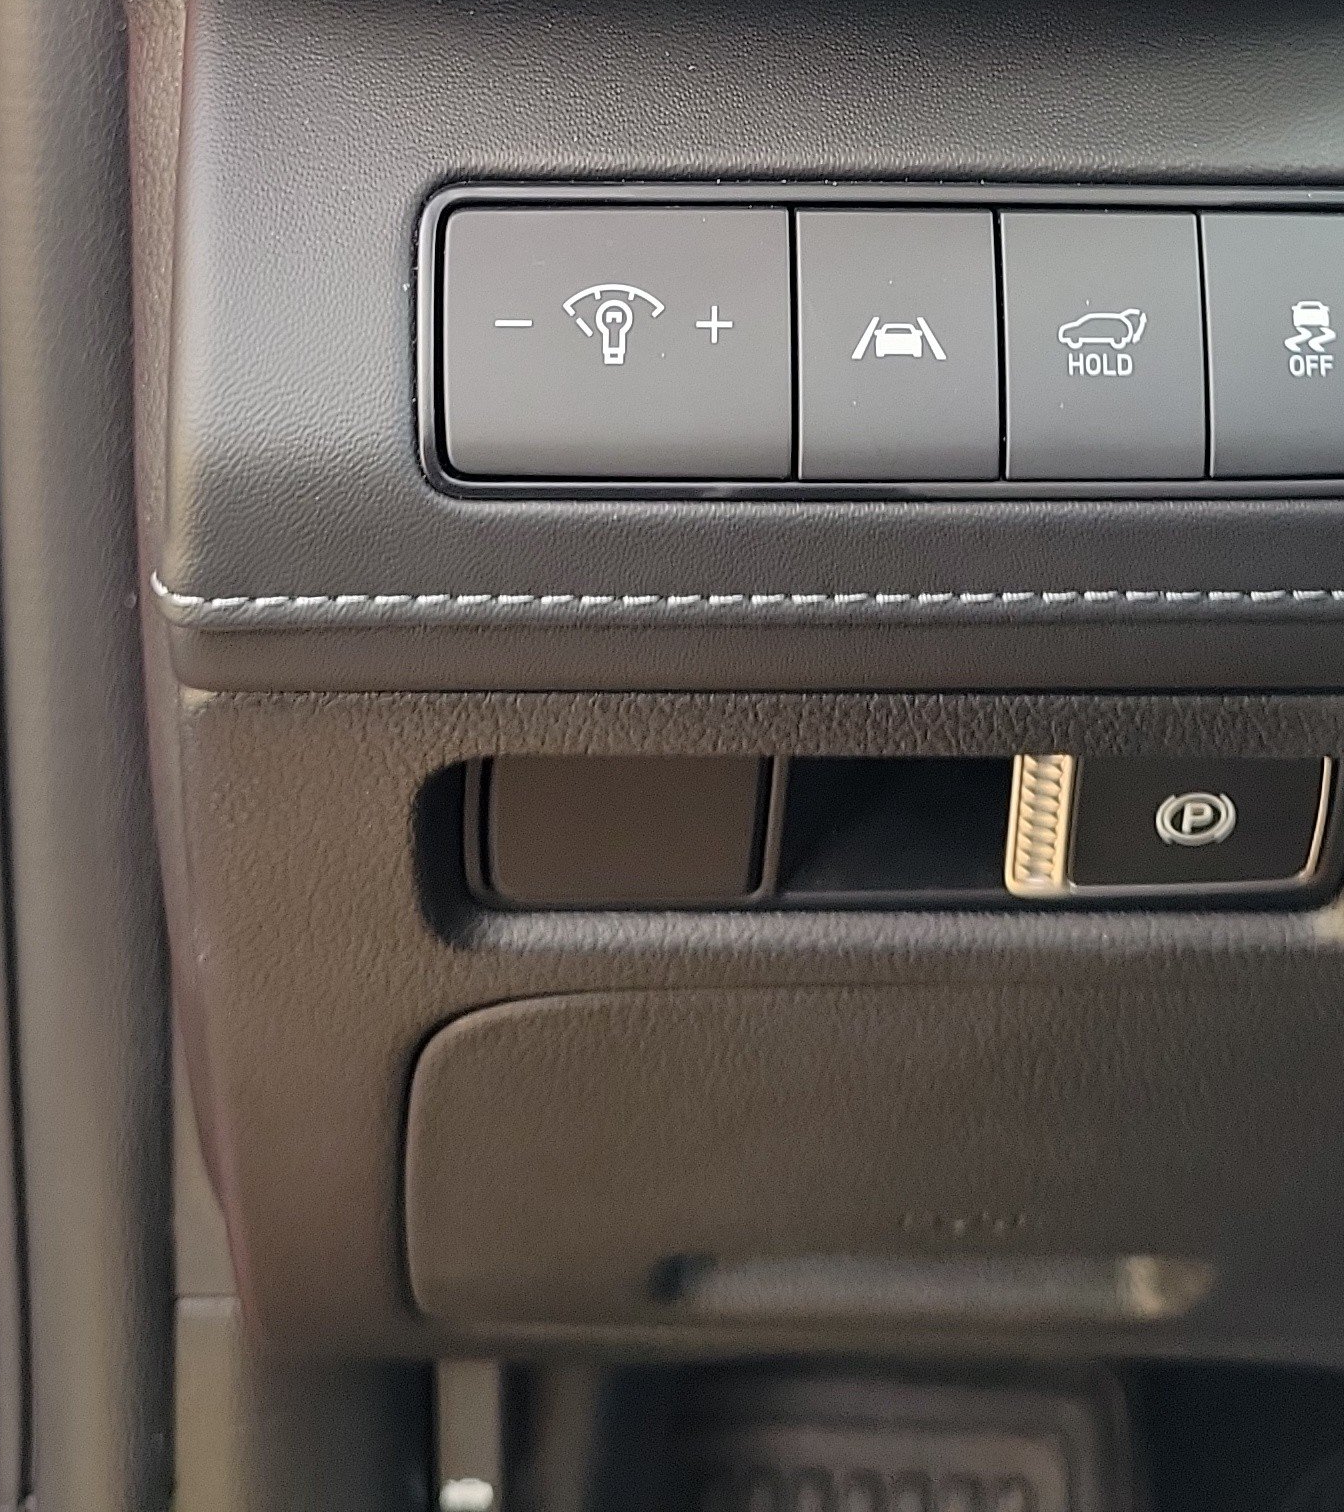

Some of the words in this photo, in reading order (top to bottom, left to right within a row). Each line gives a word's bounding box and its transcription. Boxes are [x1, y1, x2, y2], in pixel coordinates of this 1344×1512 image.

[1068, 353, 1133, 377] HOLD
[1289, 354, 1334, 378] OFF
[1181, 801, 1214, 835] P
